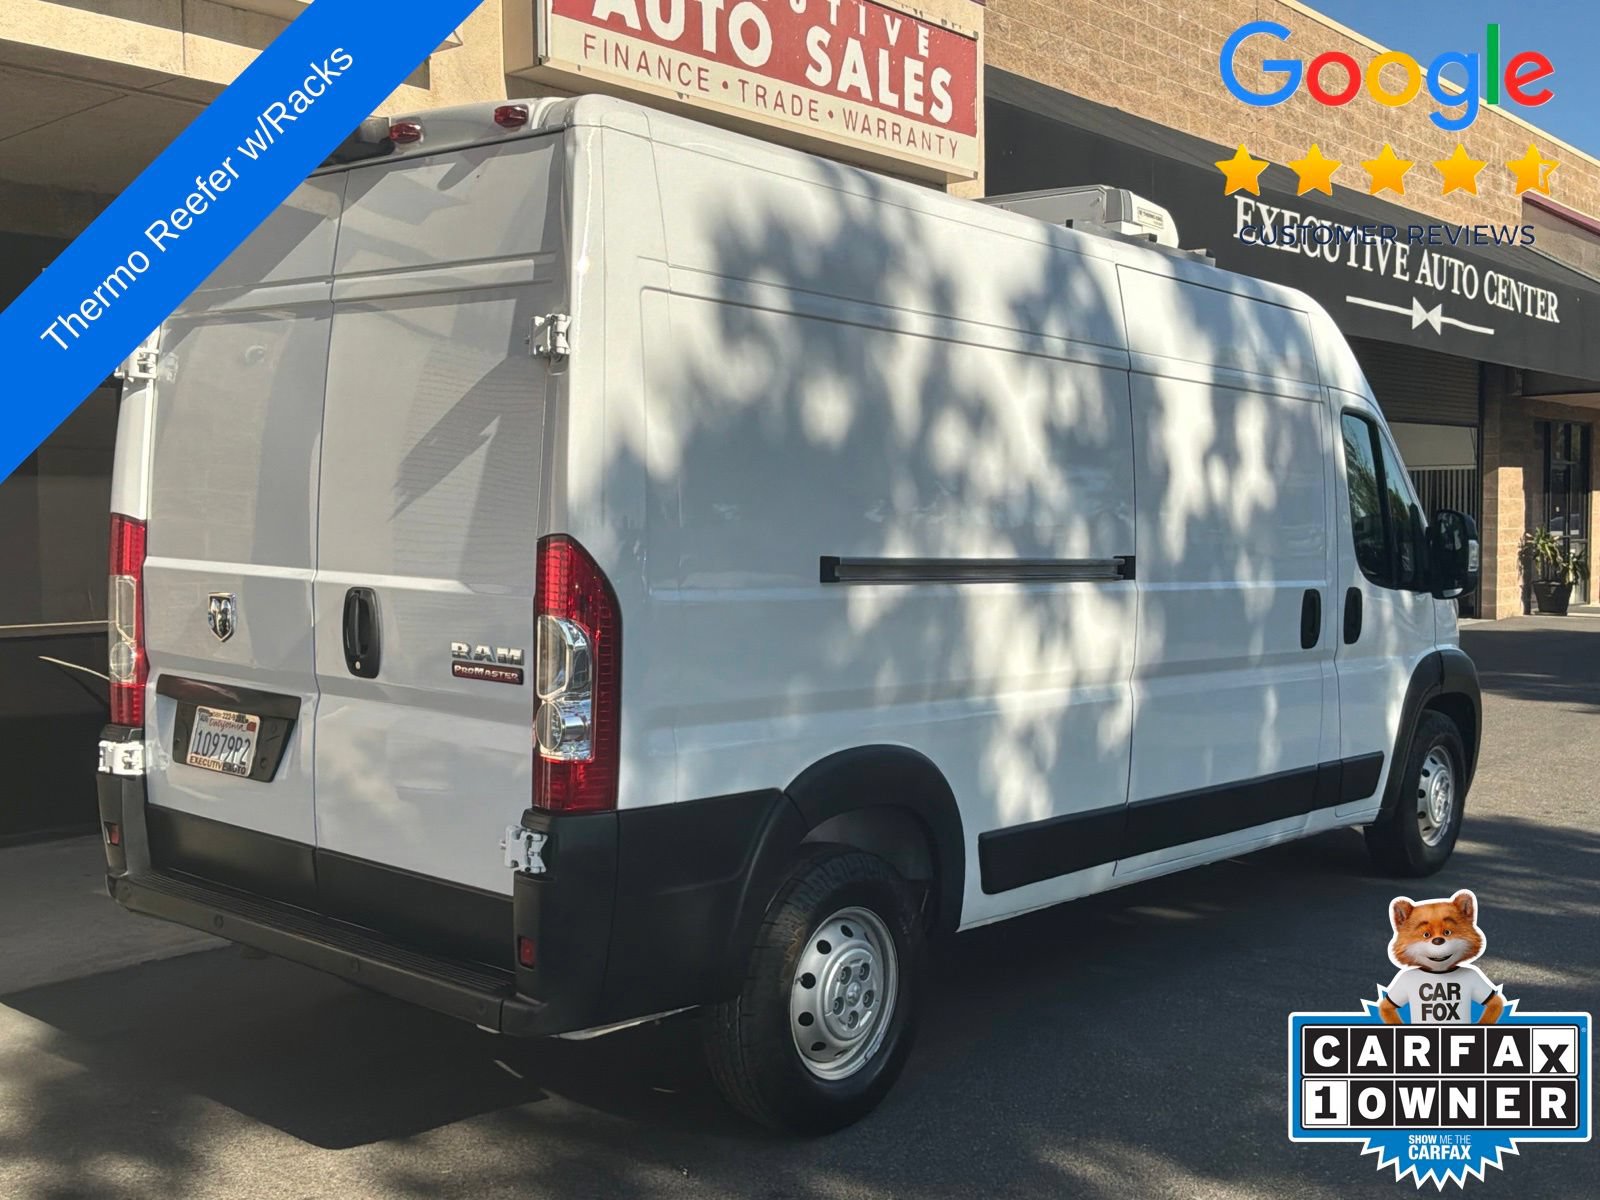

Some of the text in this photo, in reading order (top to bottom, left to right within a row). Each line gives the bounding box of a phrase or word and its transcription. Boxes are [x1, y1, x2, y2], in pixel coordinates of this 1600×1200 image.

[583, 33, 958, 159] FINANCE TRADE WARRANTY
[805, 25, 953, 124] SALES
[1233, 194, 1560, 324] EXECUTIVE AUTO CENTER
[451, 641, 524, 666] RAM
[192, 730, 251, 766] 10979P2
